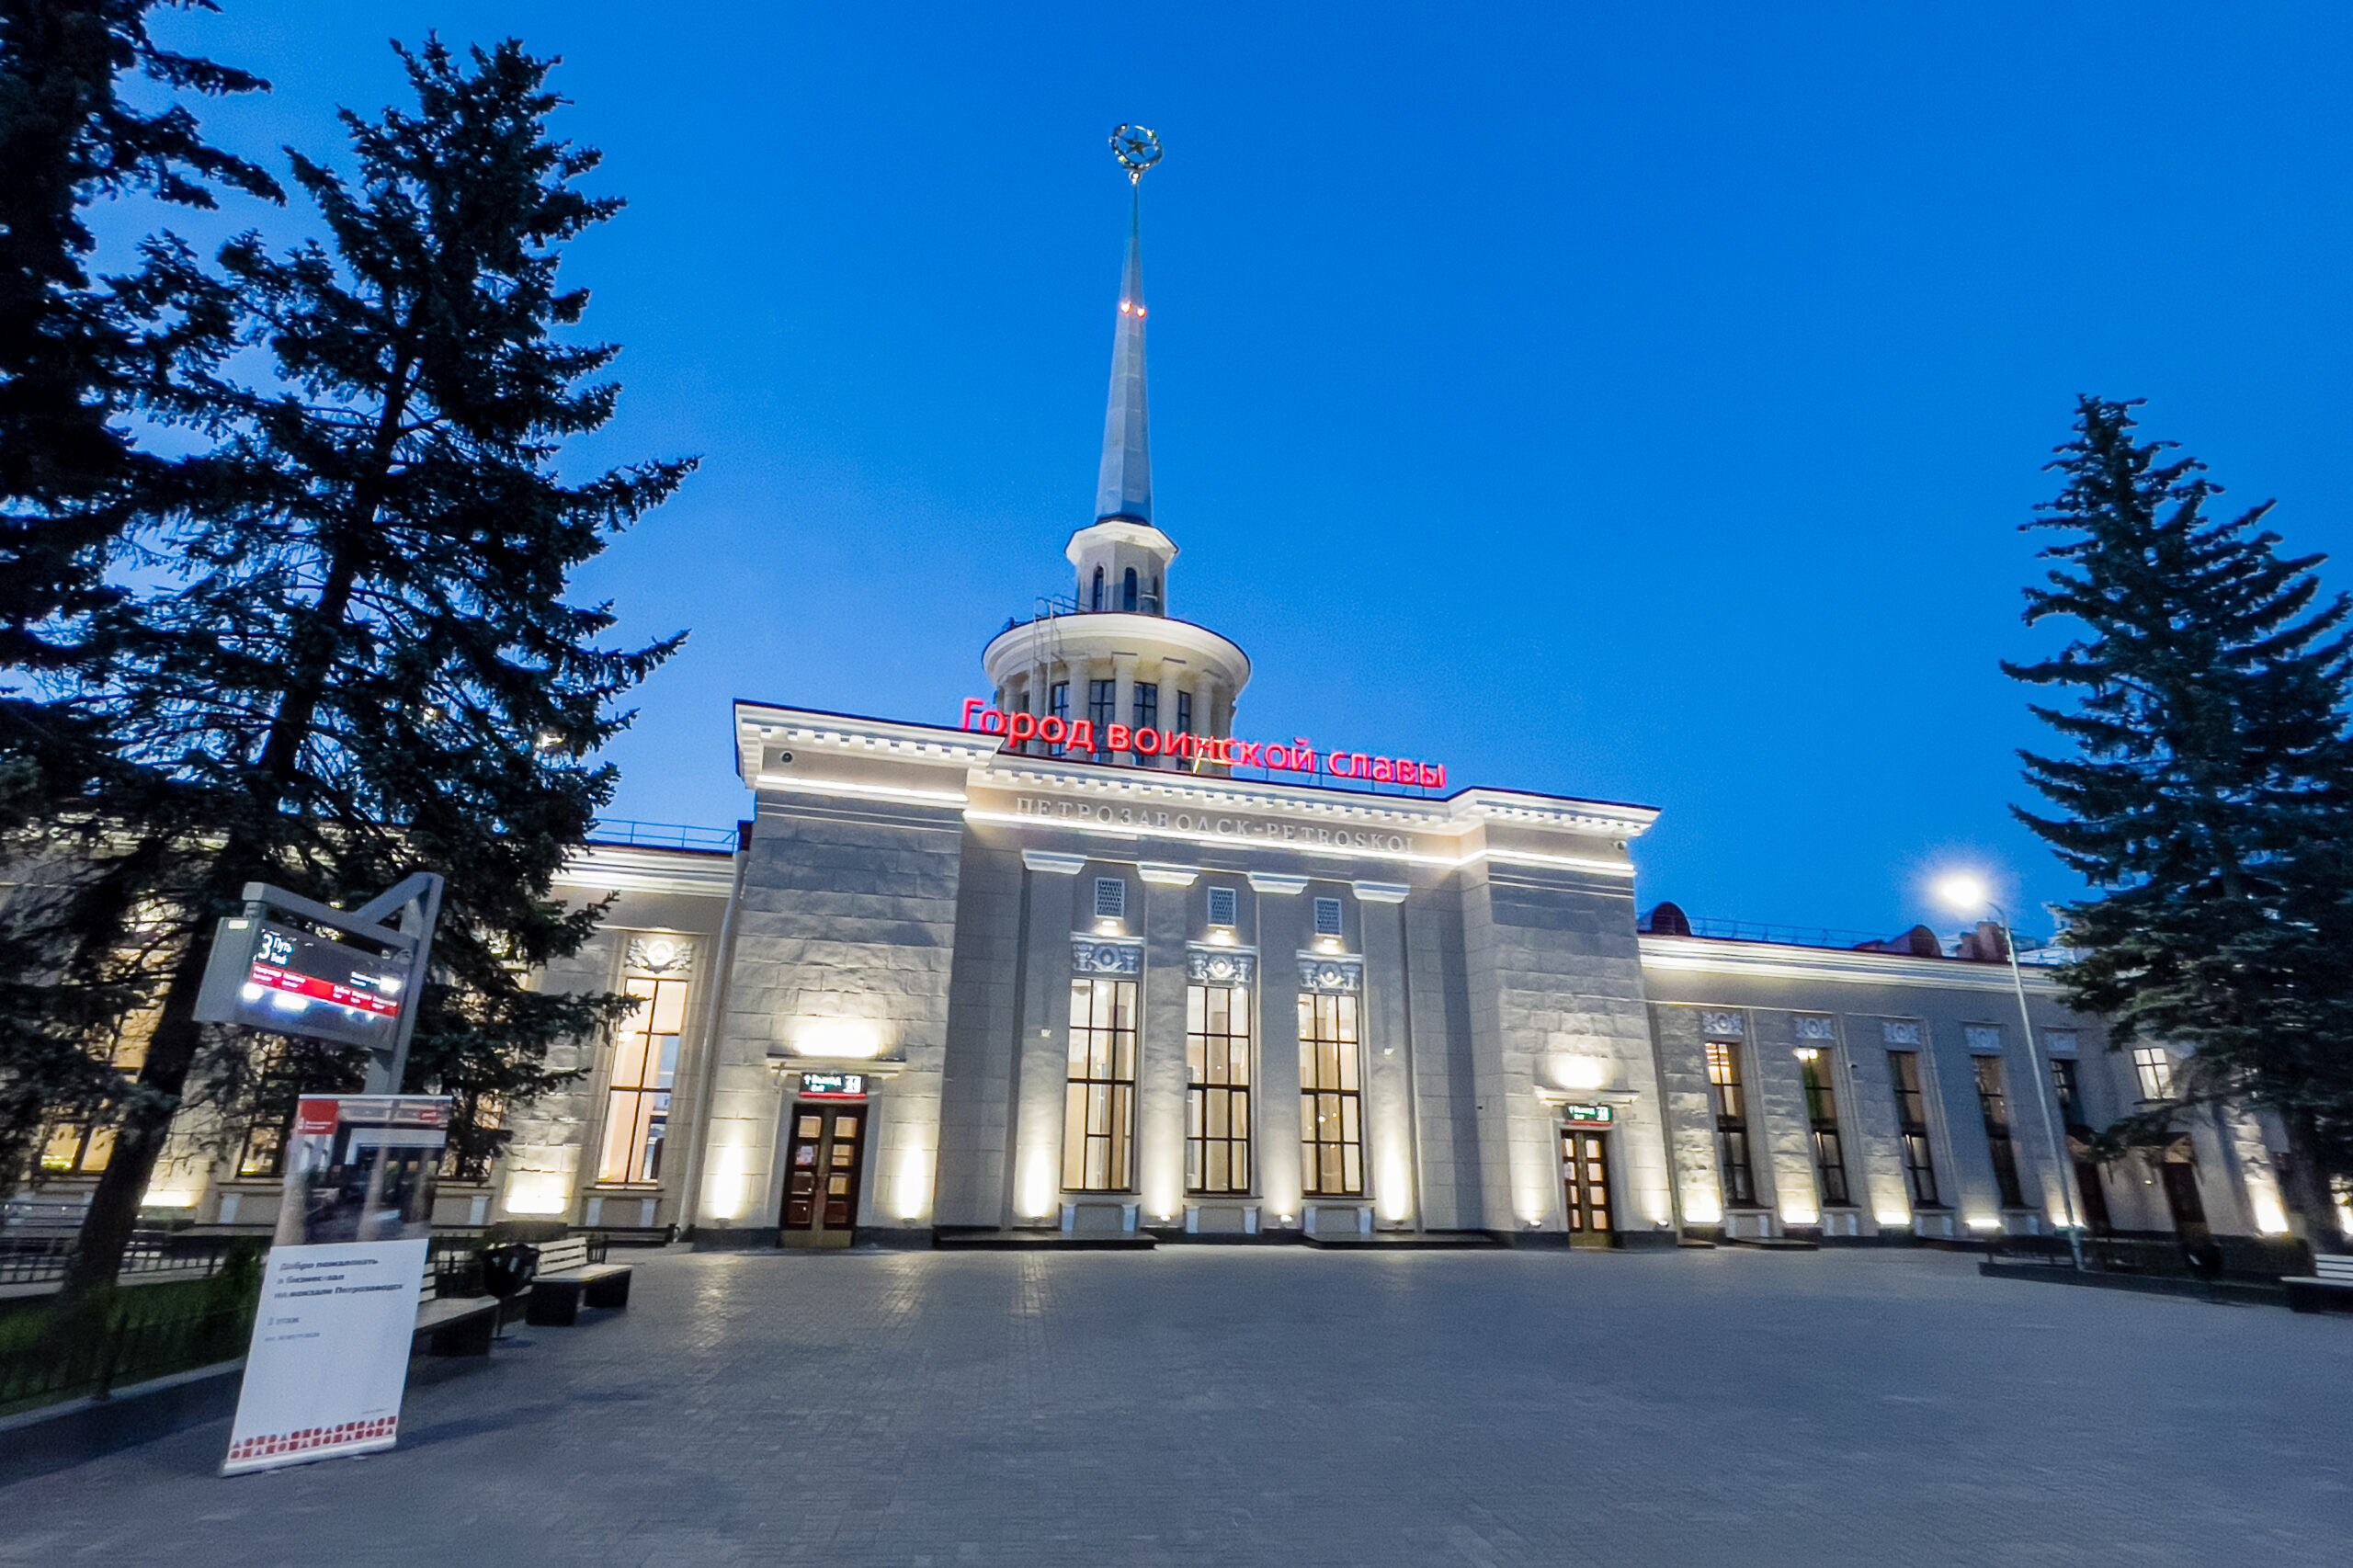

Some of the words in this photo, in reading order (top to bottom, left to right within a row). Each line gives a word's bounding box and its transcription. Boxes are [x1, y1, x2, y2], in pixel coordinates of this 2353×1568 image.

[961, 697, 1097, 754] Город
[1107, 722, 1316, 773] воинской
[1328, 750, 1448, 789] славы
[257, 932, 274, 960] 3
